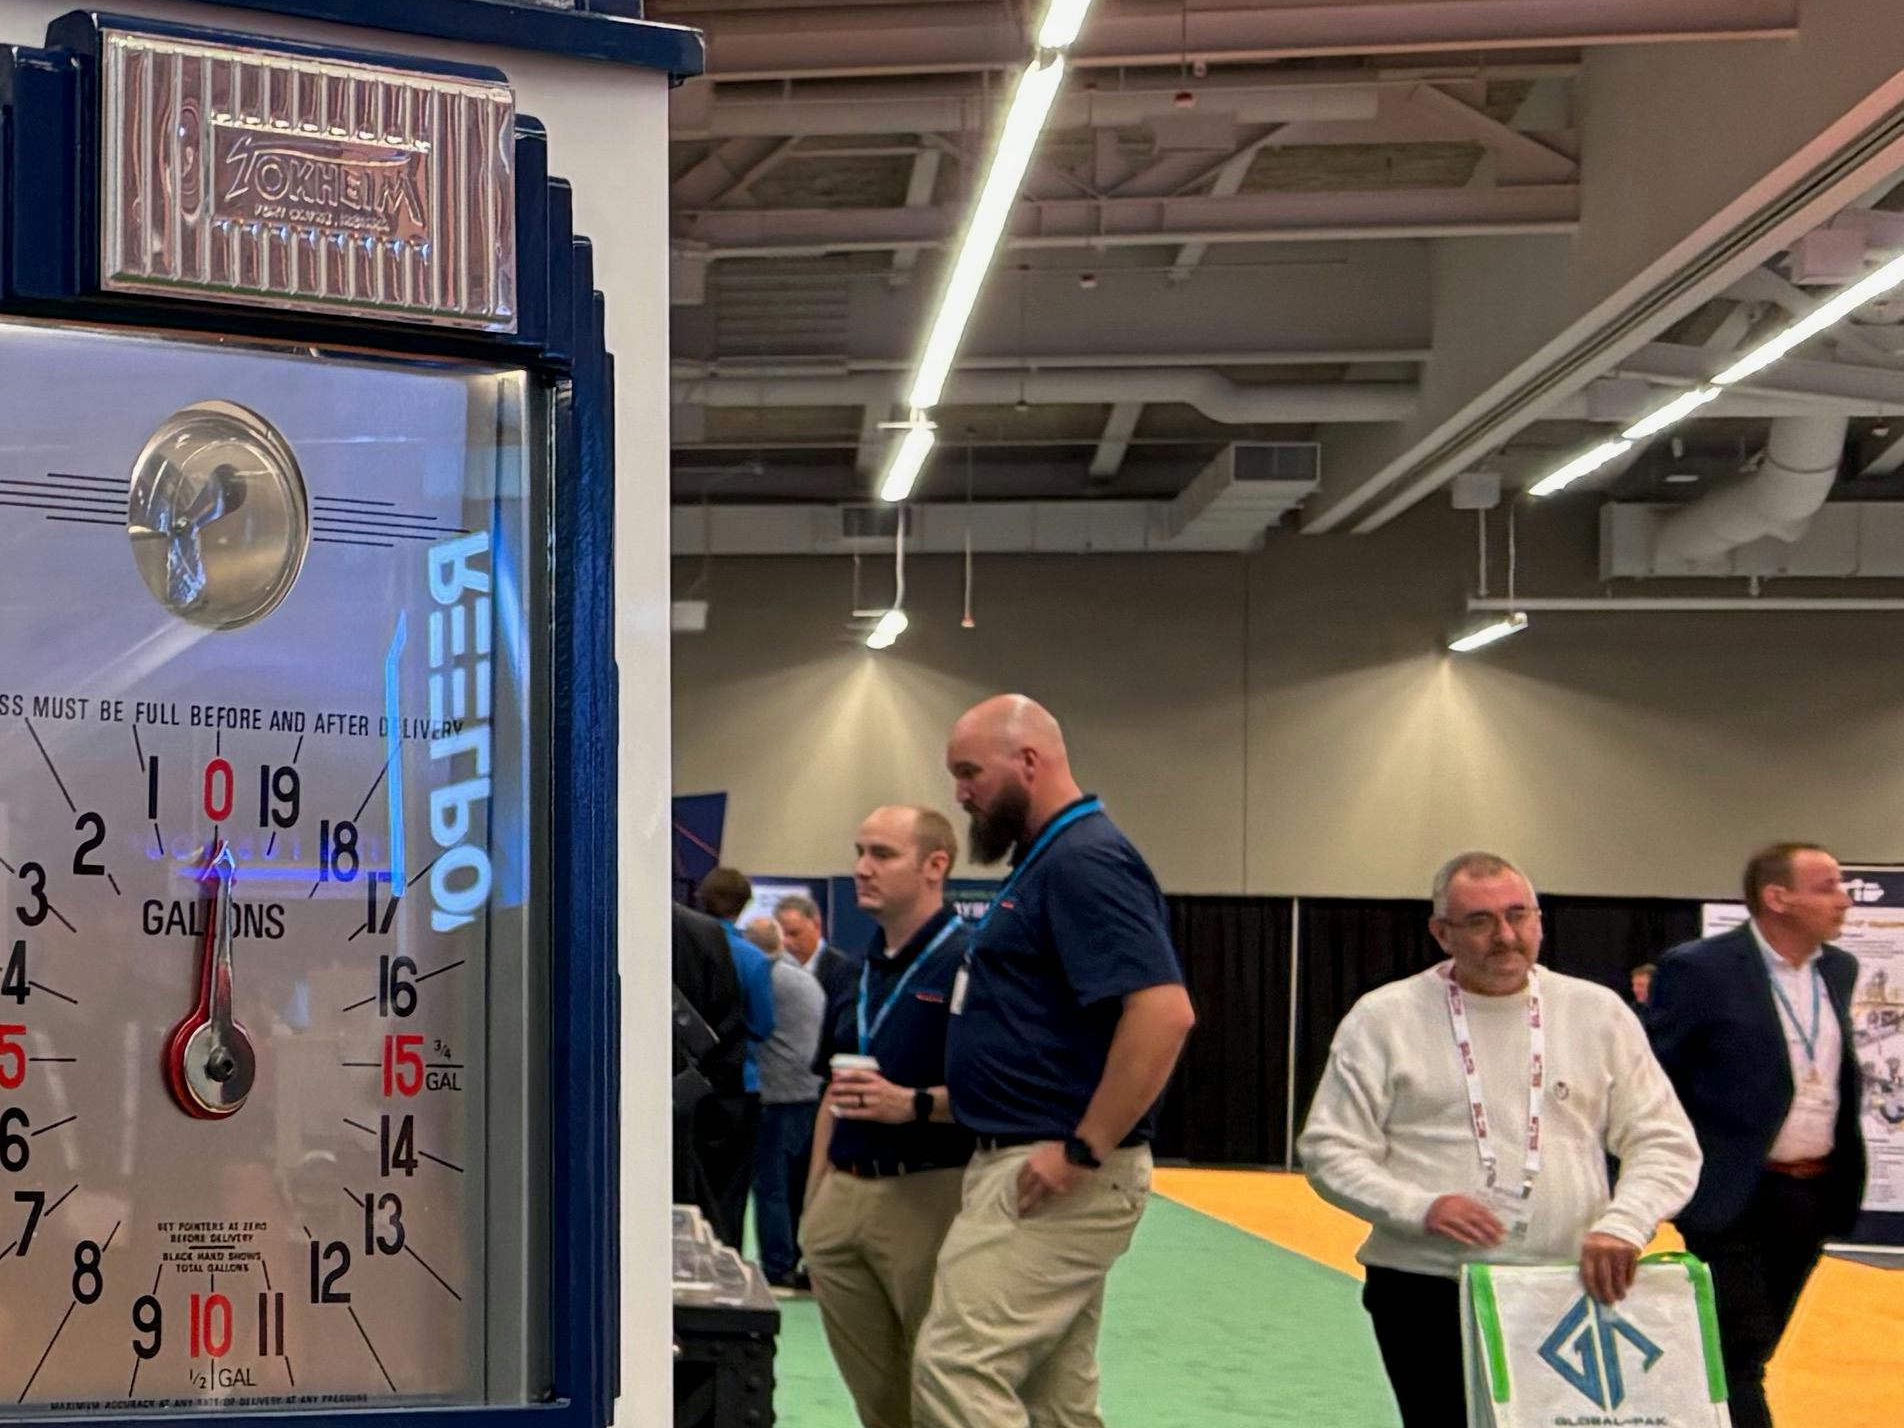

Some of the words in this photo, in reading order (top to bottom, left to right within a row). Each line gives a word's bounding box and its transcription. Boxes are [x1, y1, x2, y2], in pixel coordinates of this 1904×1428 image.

[32, 696, 89, 722] MUST
[98, 699, 125, 724] BE
[135, 701, 180, 727] FULL
[190, 704, 262, 732] BEFORE
[269, 708, 306, 735] AND
[314, 711, 370, 737] AFTER
[378, 715, 465, 742] DLIVERY
[149, 755, 159, 820] 1
[204, 757, 234, 822] 0
[259, 764, 300, 829] 19
[73, 811, 106, 876] 2
[319, 819, 359, 883] 18
[16, 861, 49, 926] 3
[366, 870, 402, 935] 17
[0, 940, 31, 1006] 4
[378, 955, 418, 1018] 16
[383, 1034, 424, 1098] 15
[425, 1071, 462, 1093] GAL
[432, 1039, 452, 1062] 3/4
[379, 1114, 418, 1178] 14
[14, 1190, 46, 1257] 7
[170, 1233, 205, 1244] BEFORE
[210, 1233, 254, 1244] DELIVERY
[178, 1221, 224, 1232] POINTERS
[364, 1192, 404, 1256] 13
[73, 1240, 103, 1305] 8
[163, 1252, 193, 1262] BLACK
[197, 1251, 224, 1261] HAND
[228, 1251, 261, 1261] SHOWS
[176, 1263, 204, 1273] TOTAL
[207, 1263, 249, 1273] GALLONS
[310, 1240, 352, 1305] 12
[132, 1295, 162, 1359] 9
[190, 1293, 232, 1358] 10
[258, 1292, 284, 1357] 11
[50, 1400, 100, 1412] MAXIMUM
[218, 1366, 257, 1388] GAL
[1554, 1416, 1667, 1428] GLOBAL-PAK
